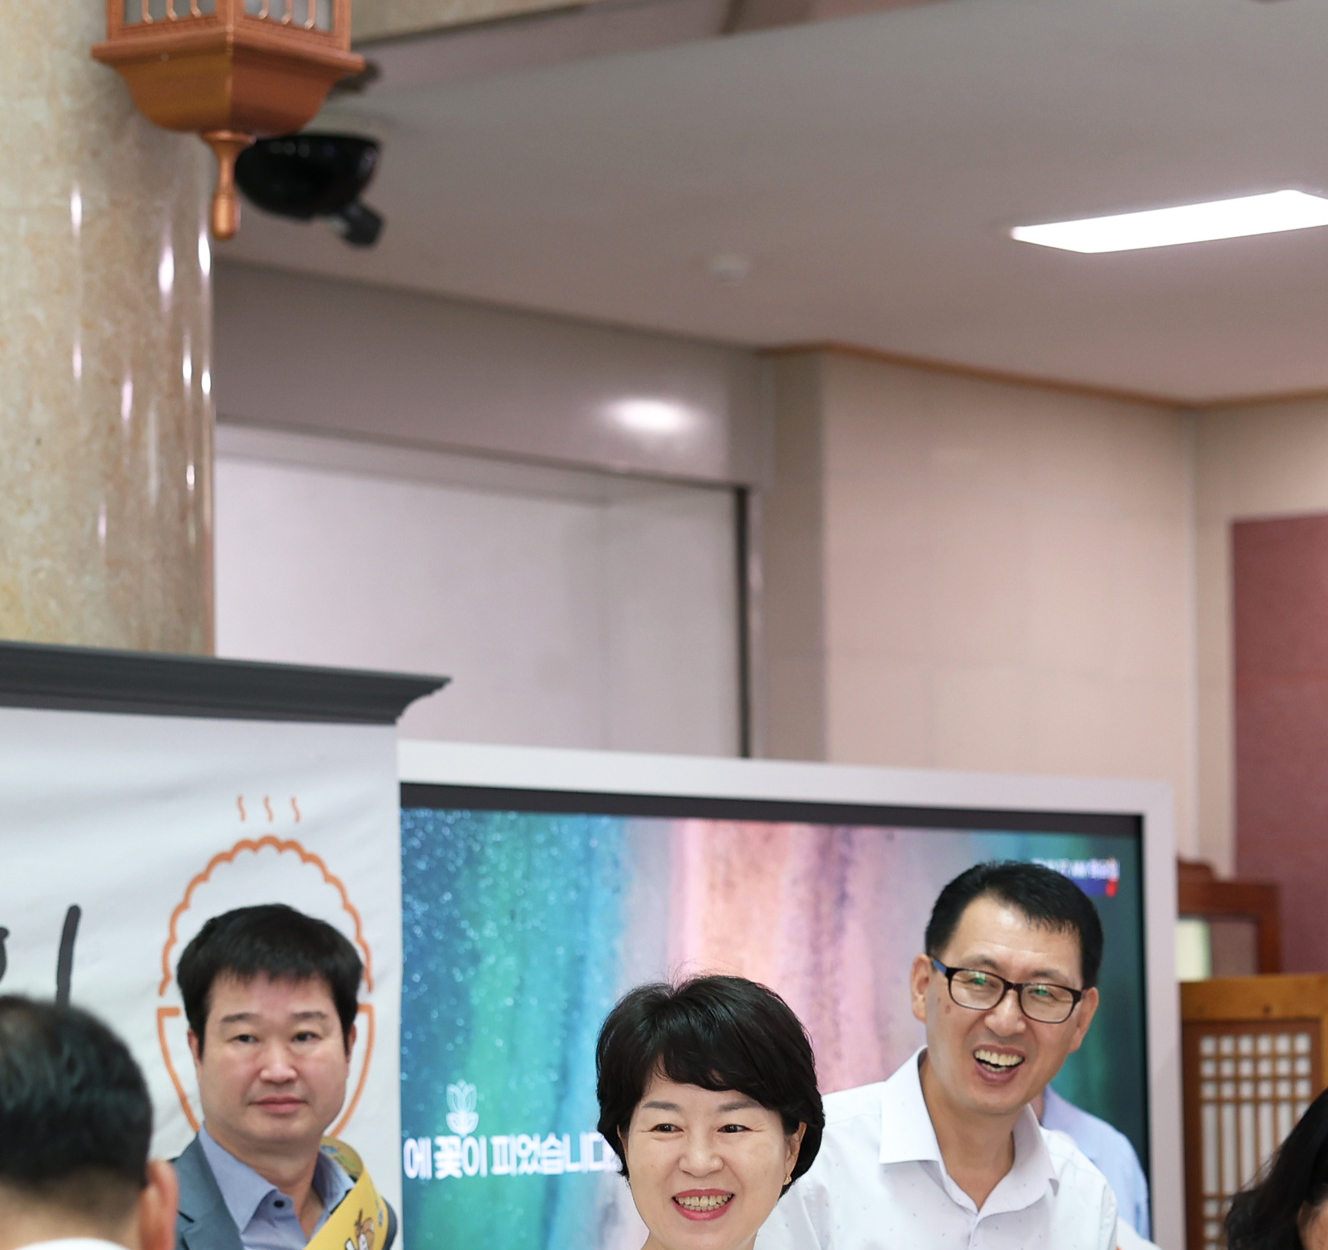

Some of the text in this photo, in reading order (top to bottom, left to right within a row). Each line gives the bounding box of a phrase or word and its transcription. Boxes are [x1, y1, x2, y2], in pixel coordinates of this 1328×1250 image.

[404, 1132, 623, 1180] 에 꽃이 피었습니다
